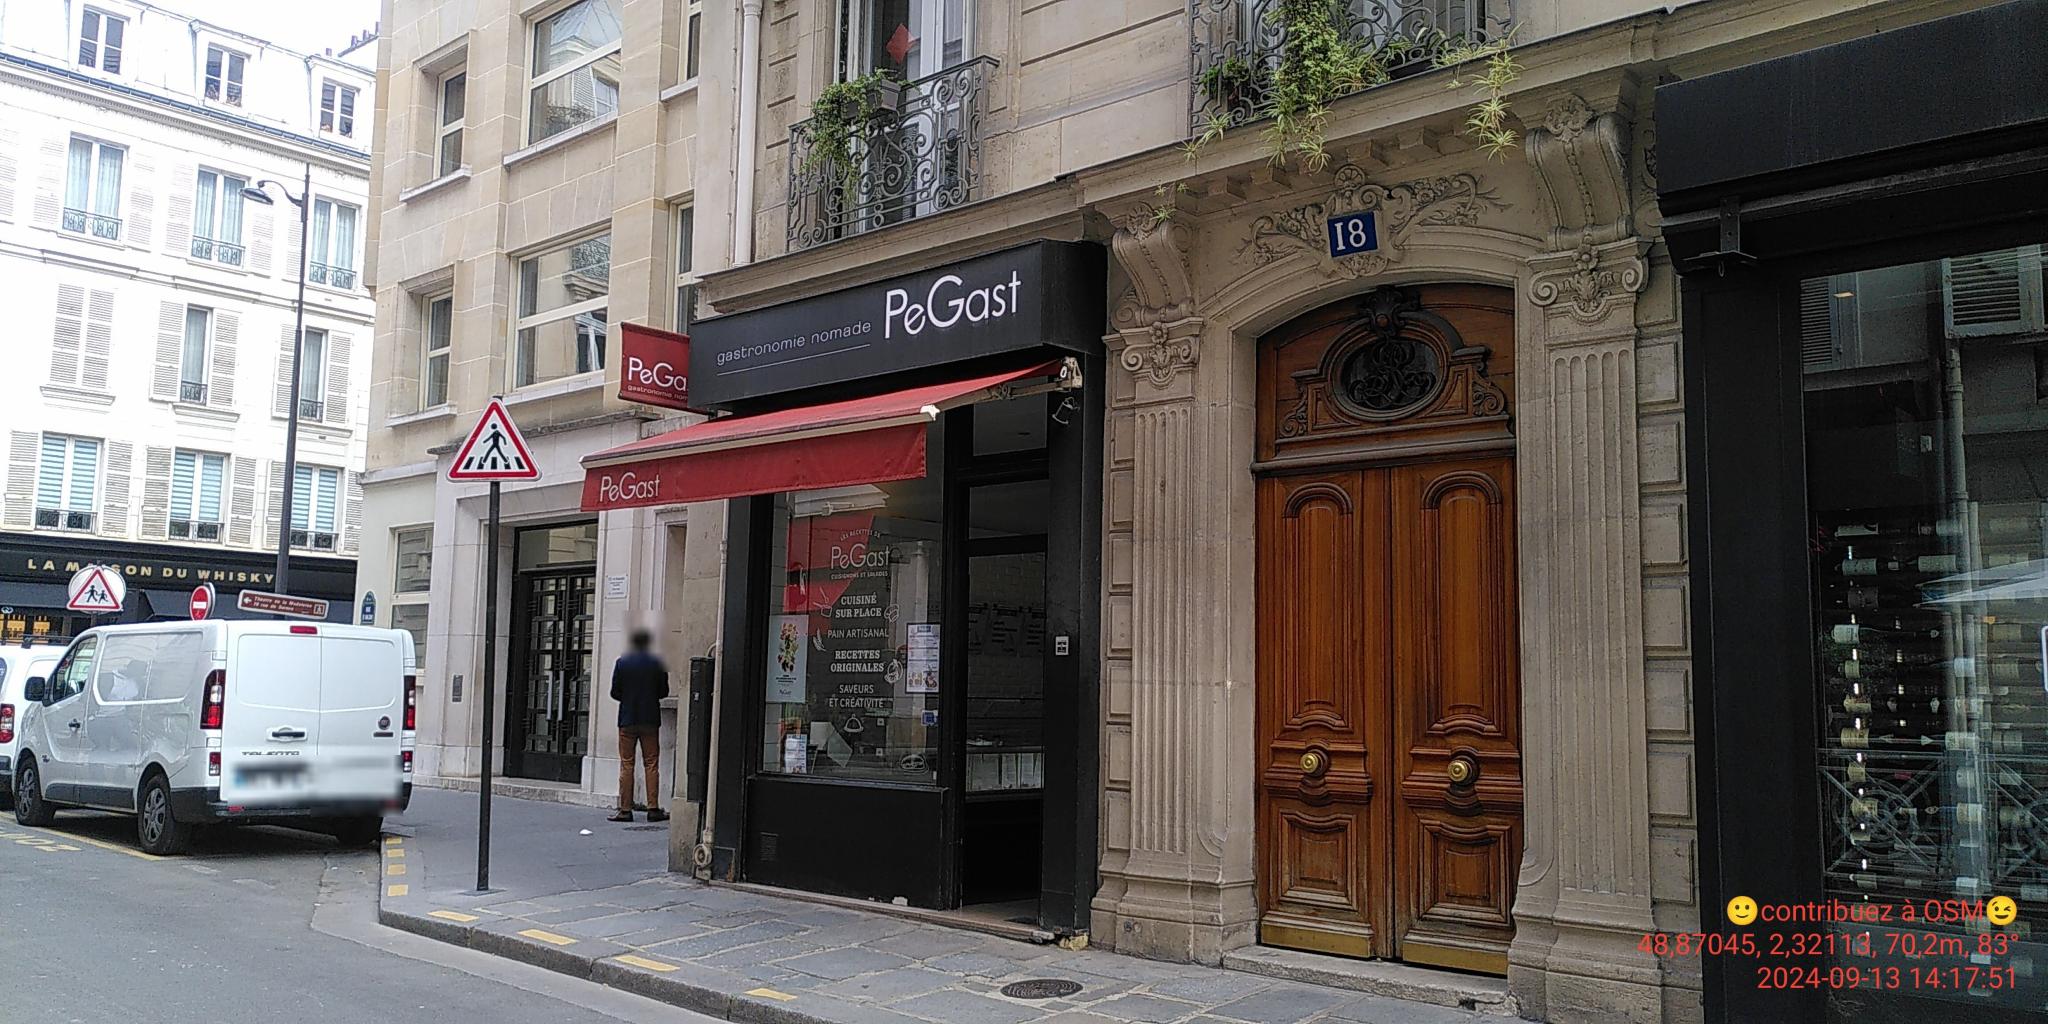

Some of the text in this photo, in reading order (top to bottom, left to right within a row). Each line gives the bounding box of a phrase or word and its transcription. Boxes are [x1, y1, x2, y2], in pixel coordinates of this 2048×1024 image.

[1334, 219, 1366, 251] 18
[884, 270, 1022, 339] PeGast
[717, 320, 872, 366] gastronomie nomade
[628, 356, 689, 391] PeGa
[627, 384, 673, 398] gastronomie
[599, 471, 661, 502] PeGast
[831, 543, 890, 570] PeGast
[27, 558, 275, 584] LA MSON DU WHISKY
[840, 591, 877, 605] CUISINÉ
[835, 607, 882, 618] SUR PLACE
[827, 628, 889, 639] PAIN ARTISANAL
[835, 650, 881, 660] RECETTES
[830, 662, 885, 673] ORIGINALES
[839, 684, 875, 694] SAVEURS
[829, 697, 839, 708] ET
